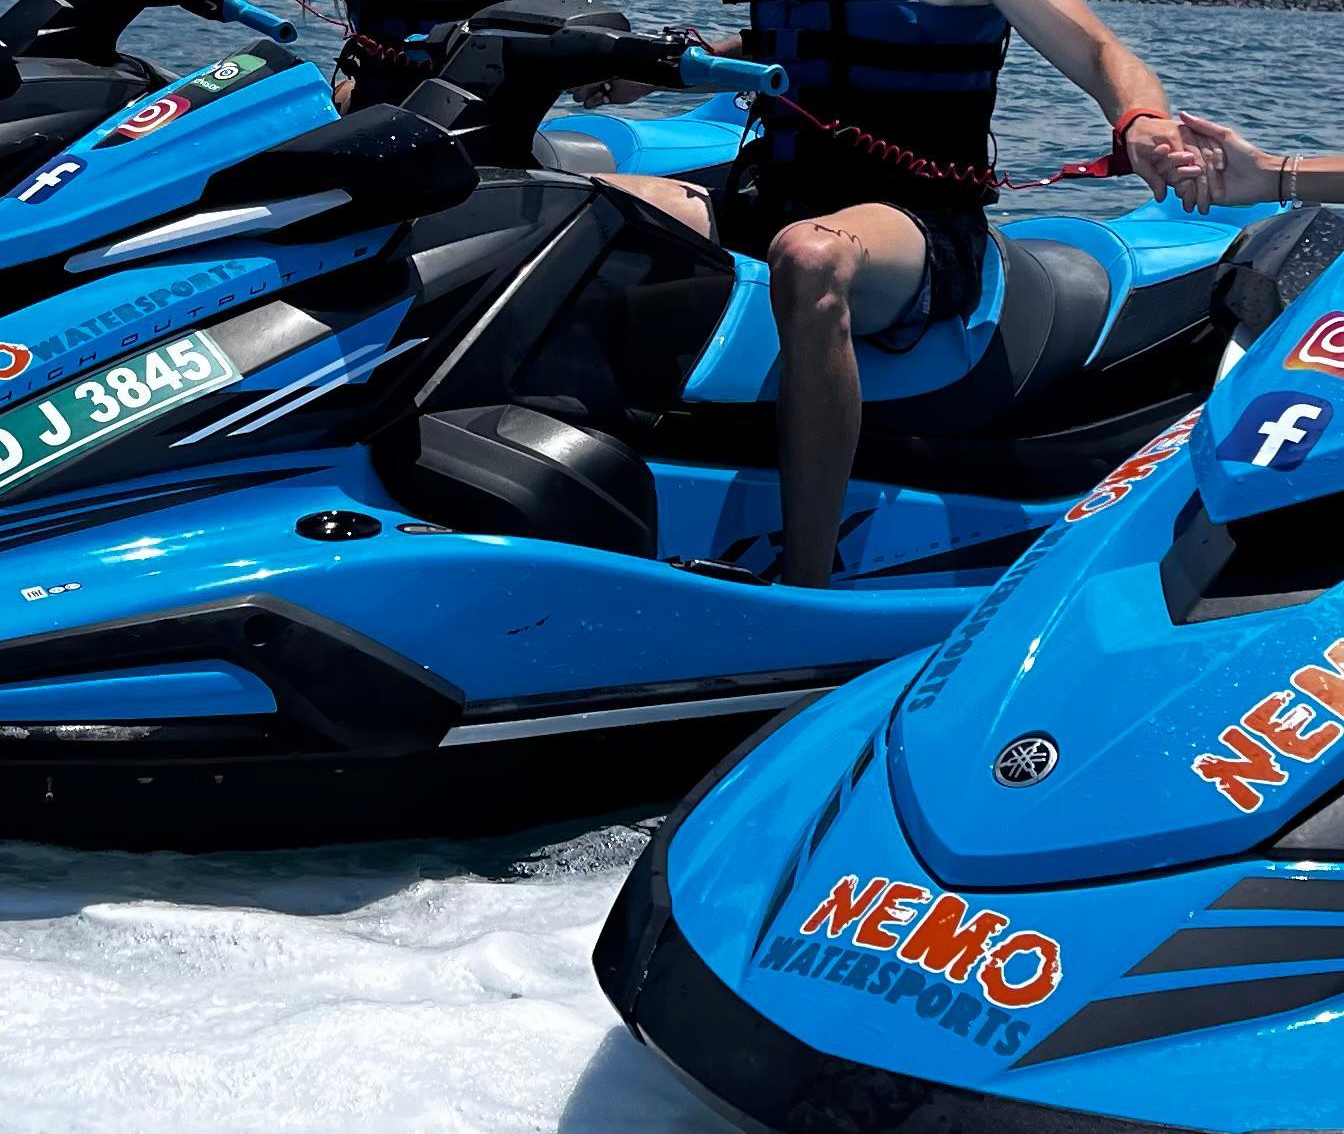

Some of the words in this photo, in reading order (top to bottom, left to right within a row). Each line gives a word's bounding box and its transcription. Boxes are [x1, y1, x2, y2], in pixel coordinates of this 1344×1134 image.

[29, 261, 249, 362] WATERSPORTS
[120, 271, 297, 349] OUTPUT
[38, 401, 73, 448] J
[74, 339, 212, 423] 3845
[759, 935, 1031, 1056] WATERSPORTS
[799, 874, 1063, 1009] NEMO
